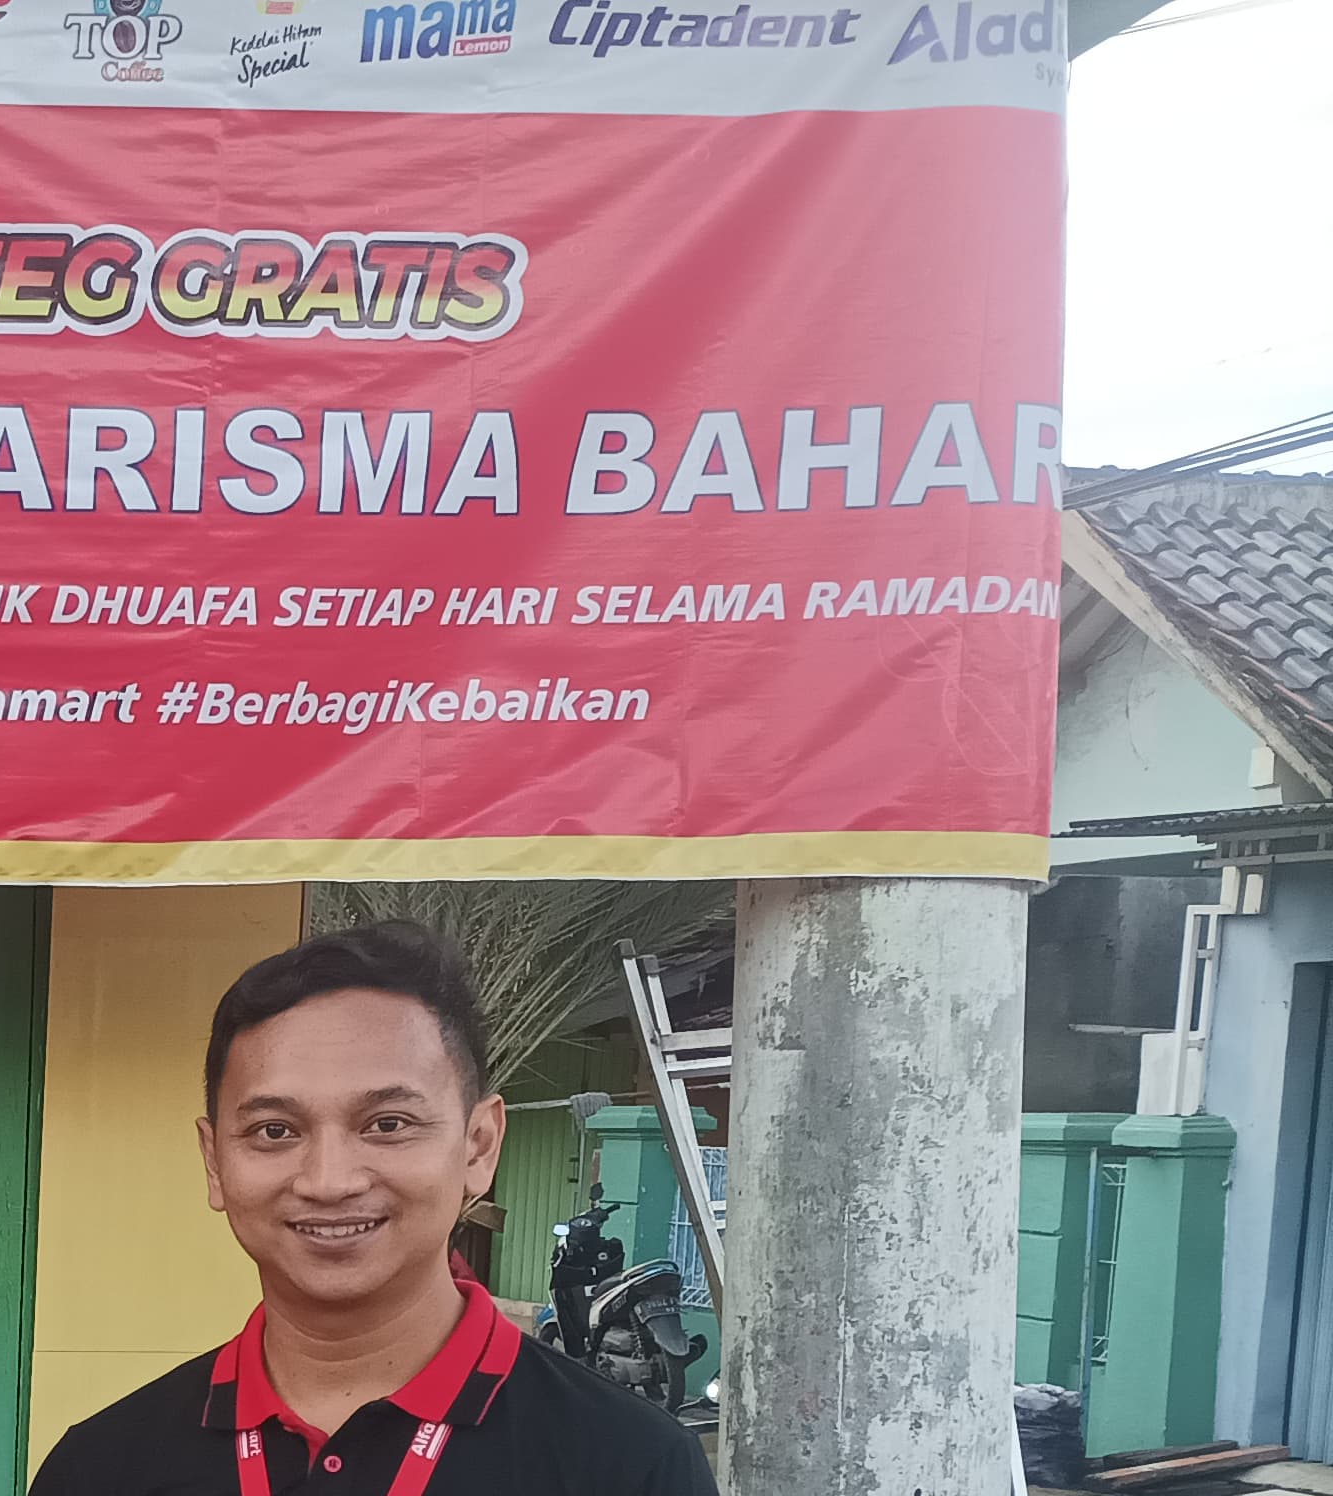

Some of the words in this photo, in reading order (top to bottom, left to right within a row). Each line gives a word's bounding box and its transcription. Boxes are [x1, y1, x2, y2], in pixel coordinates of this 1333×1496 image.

[64, 14, 182, 60] TOP
[231, 28, 280, 55] Kedelai
[283, 24, 322, 42] Hitam
[360, 0, 516, 63] mama
[456, 38, 510, 54] Lemon
[548, 0, 861, 58] Ciptadent
[101, 61, 164, 82] Coffee
[238, 43, 310, 87] Special
[149, 233, 521, 335] GRATIS
[50, 585, 257, 627] DHUAFA
[273, 587, 434, 628] SETIAP
[440, 587, 556, 627] HARI
[570, 584, 785, 625] SELAMA
[803, 575, 1058, 620] RAMADAN
[156, 678, 649, 735] #BerbagiKebaikan
